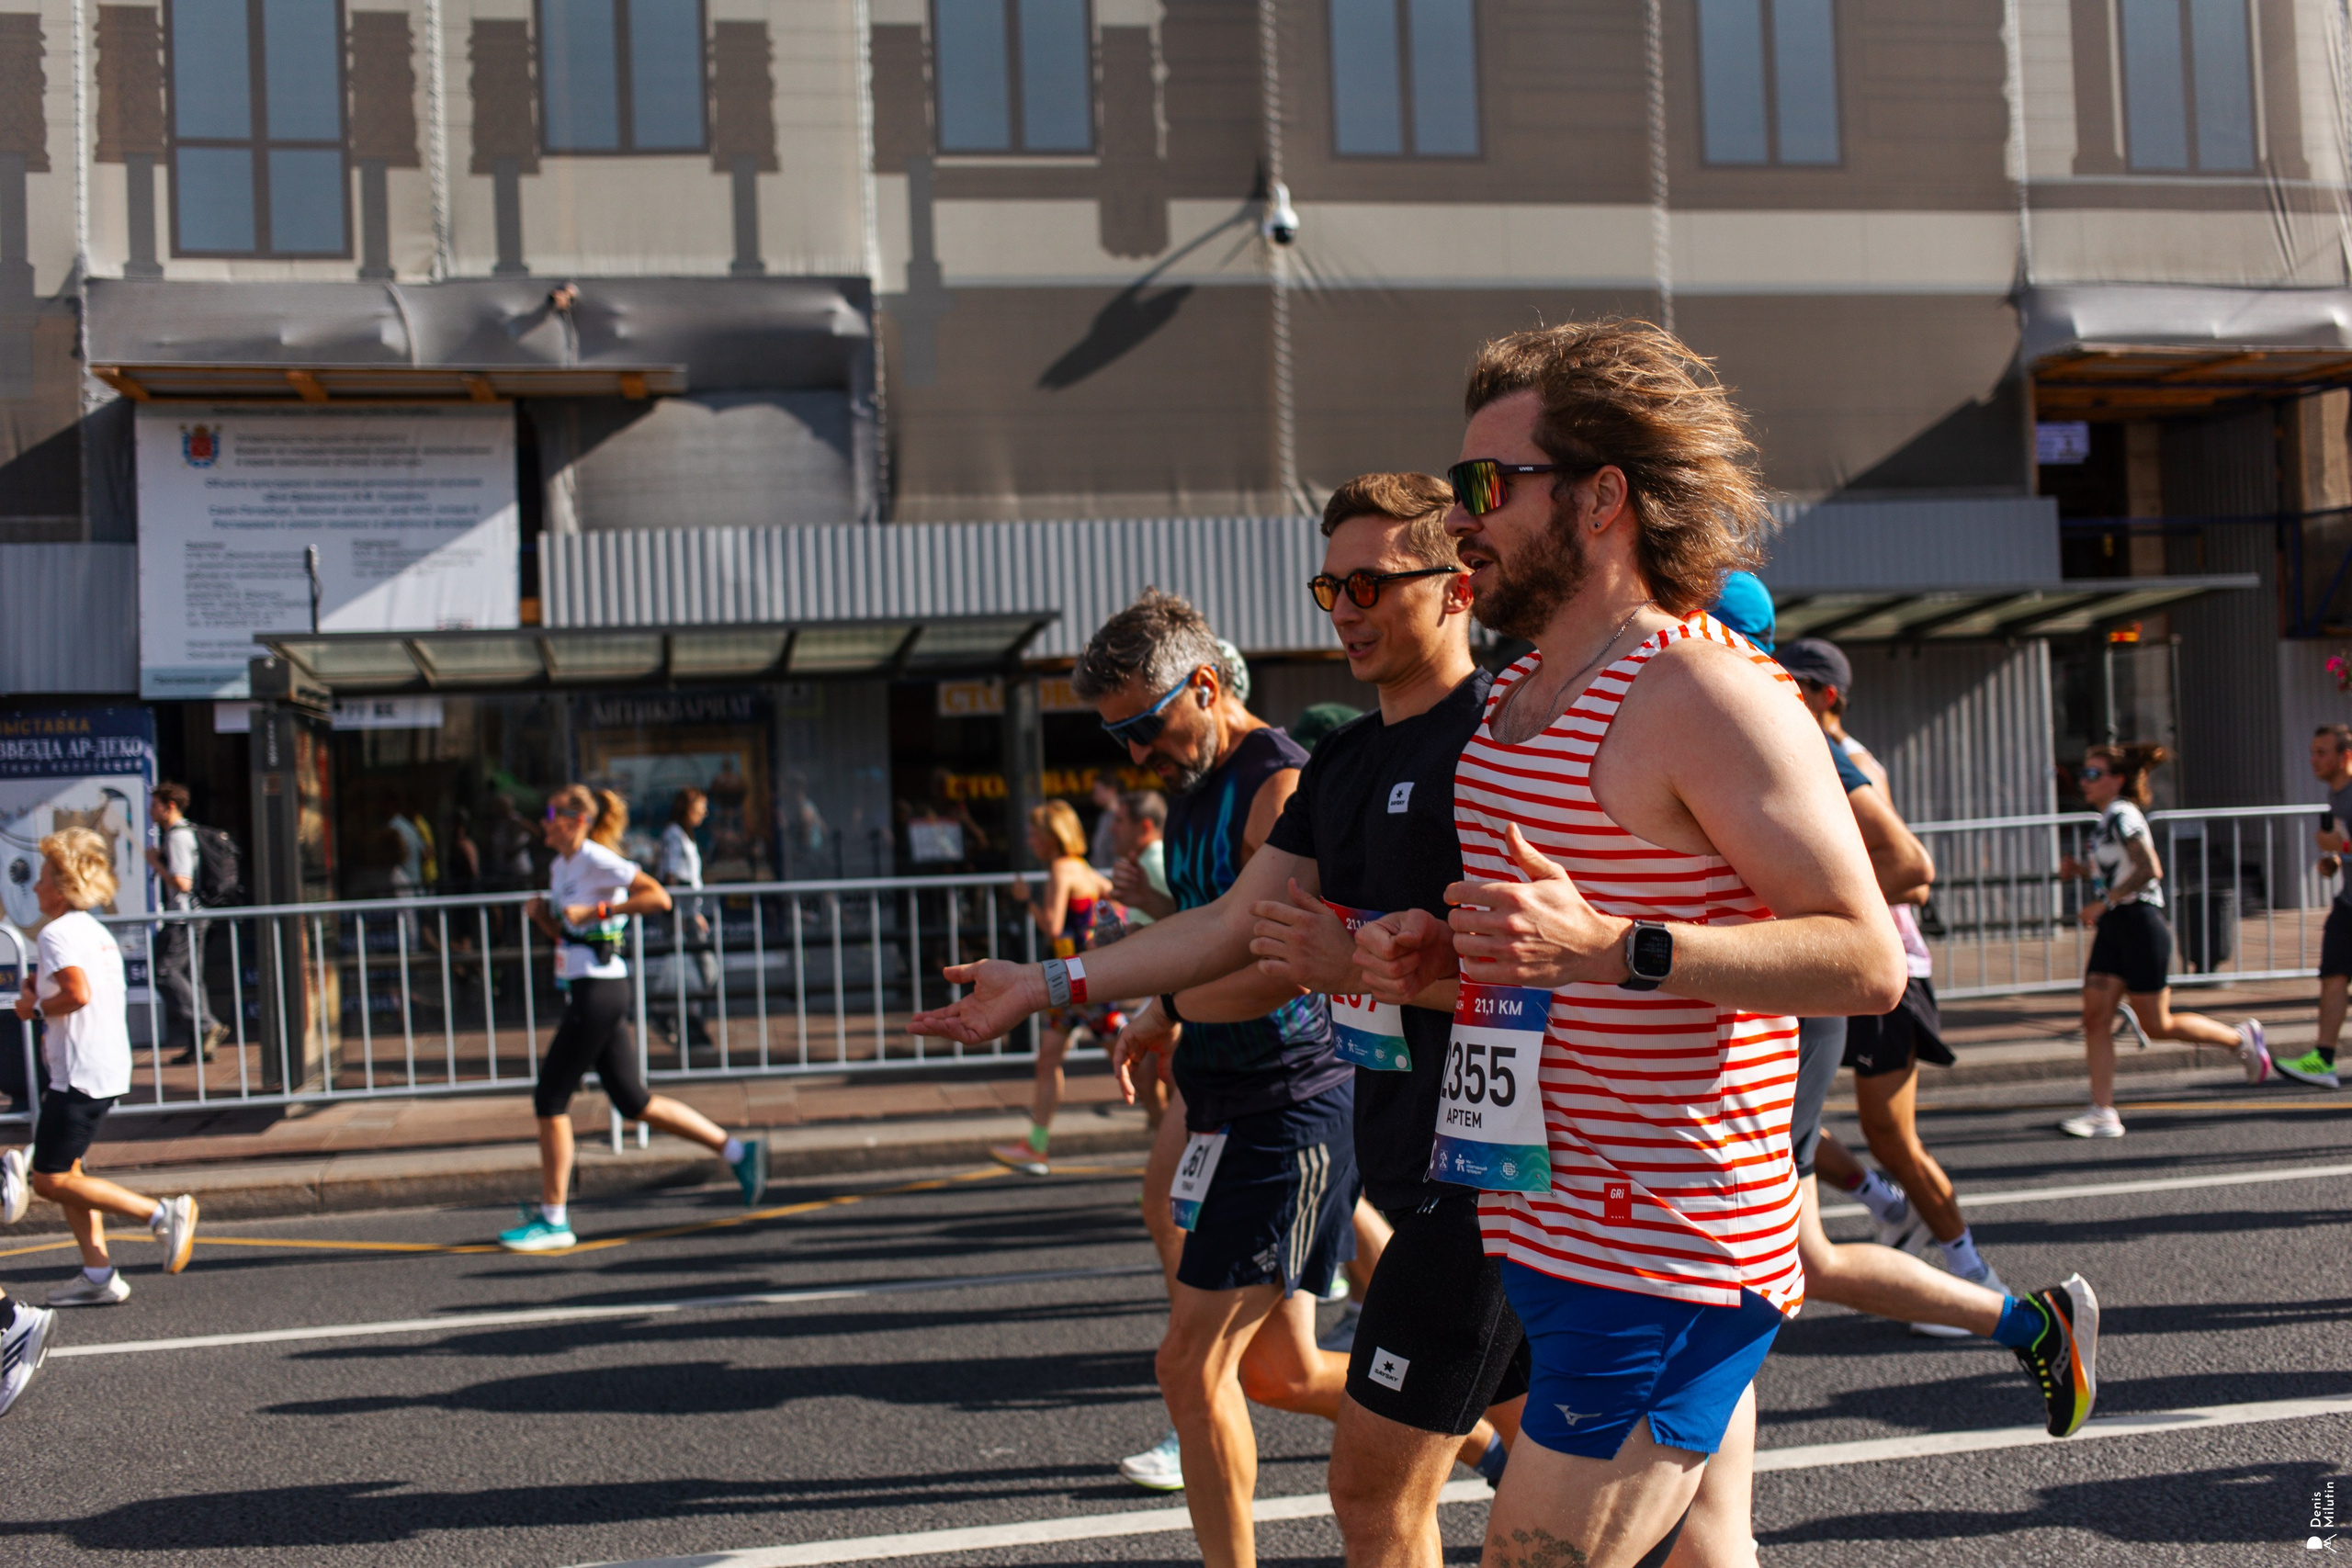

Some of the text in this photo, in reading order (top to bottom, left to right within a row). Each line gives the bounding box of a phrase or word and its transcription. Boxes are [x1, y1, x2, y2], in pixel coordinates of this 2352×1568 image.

[0, 716, 90, 736] ЫСТАВКА
[67, 736, 144, 759] АР-ДЕКО
[0, 762, 41, 773] ТНЫХ
[1474, 998, 1494, 1016] 21,1
[1446, 1108, 1482, 1129] АРТЕМ
[1374, 1369, 1398, 1382] SAYSKY
